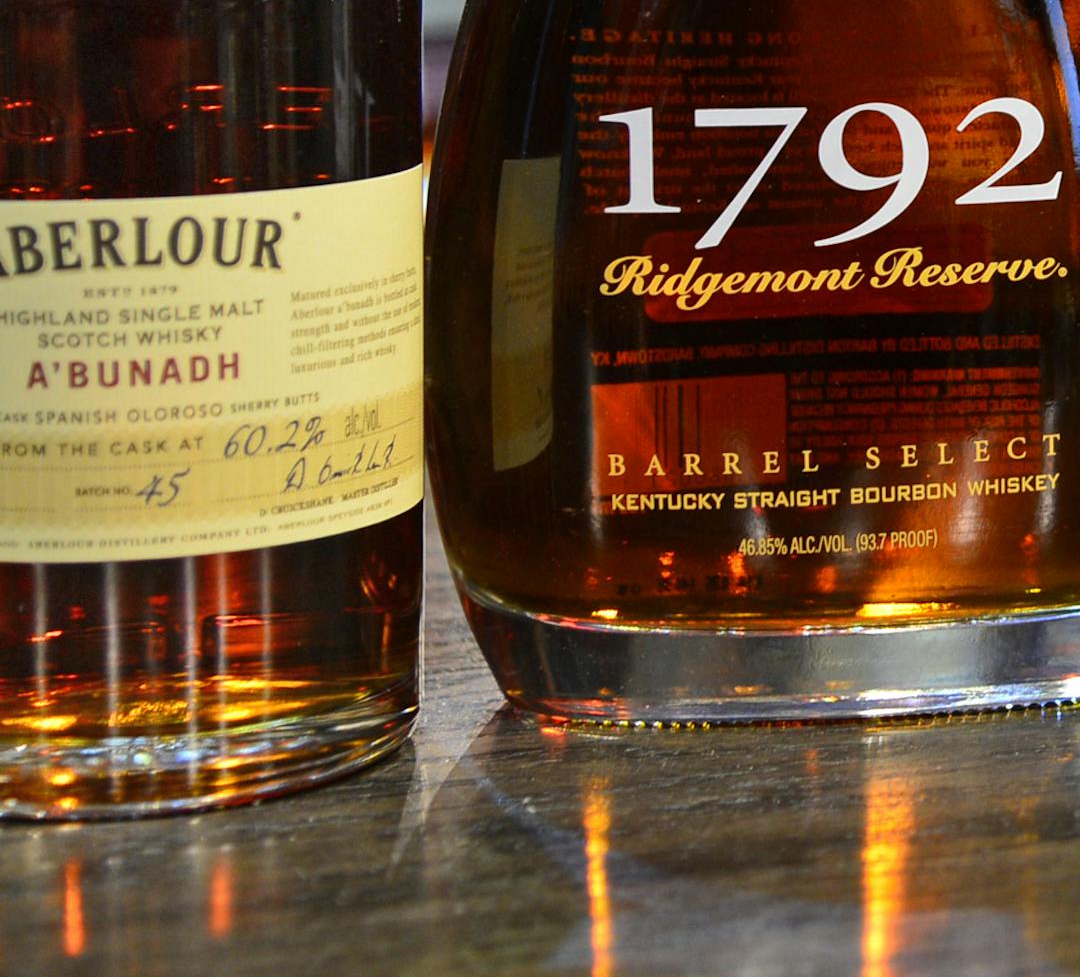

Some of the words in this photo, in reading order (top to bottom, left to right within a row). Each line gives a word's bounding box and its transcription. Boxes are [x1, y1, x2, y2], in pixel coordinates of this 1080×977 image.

[599, 96, 1064, 251] 1792
[0, 215, 282, 278] BERLOUR
[290, 287, 331, 303] Matured
[598, 255, 866, 311] Ridgemont
[869, 247, 1069, 290] Reserve.
[0, 309, 111, 325] HIGHLAND
[119, 304, 201, 324] SINGLE
[209, 299, 265, 317] MALT
[290, 305, 335, 321] Aberlour
[37, 332, 127, 349] SCOTCH
[135, 325, 223, 345] WHISKY
[290, 323, 331, 338] strength
[290, 359, 337, 374] luxurious
[357, 350, 373, 361] rich
[35, 409, 117, 424] SPANISH
[127, 402, 223, 424] OLOROSO
[230, 398, 278, 414] SHERRY
[284, 391, 320, 408] BUTTS
[0, 441, 46, 457] ROM
[58, 442, 98, 457] THE
[109, 439, 167, 456] CASK
[179, 436, 204, 451] AT
[223, 415, 327, 459] 60.2%
[607, 449, 820, 477] BARREL
[865, 433, 1062, 470] SELECT
[75, 487, 109, 498] BATCH
[135, 466, 191, 507] 45
[611, 492, 725, 512] KENTUCKY
[733, 487, 841, 509] STRAIGHT
[850, 481, 958, 505] BOURBON
[966, 472, 1061, 496] WHISKEY
[738, 537, 788, 558] 46.85%
[855, 531, 888, 553] (93.7
[890, 528, 939, 549] PROOF)
